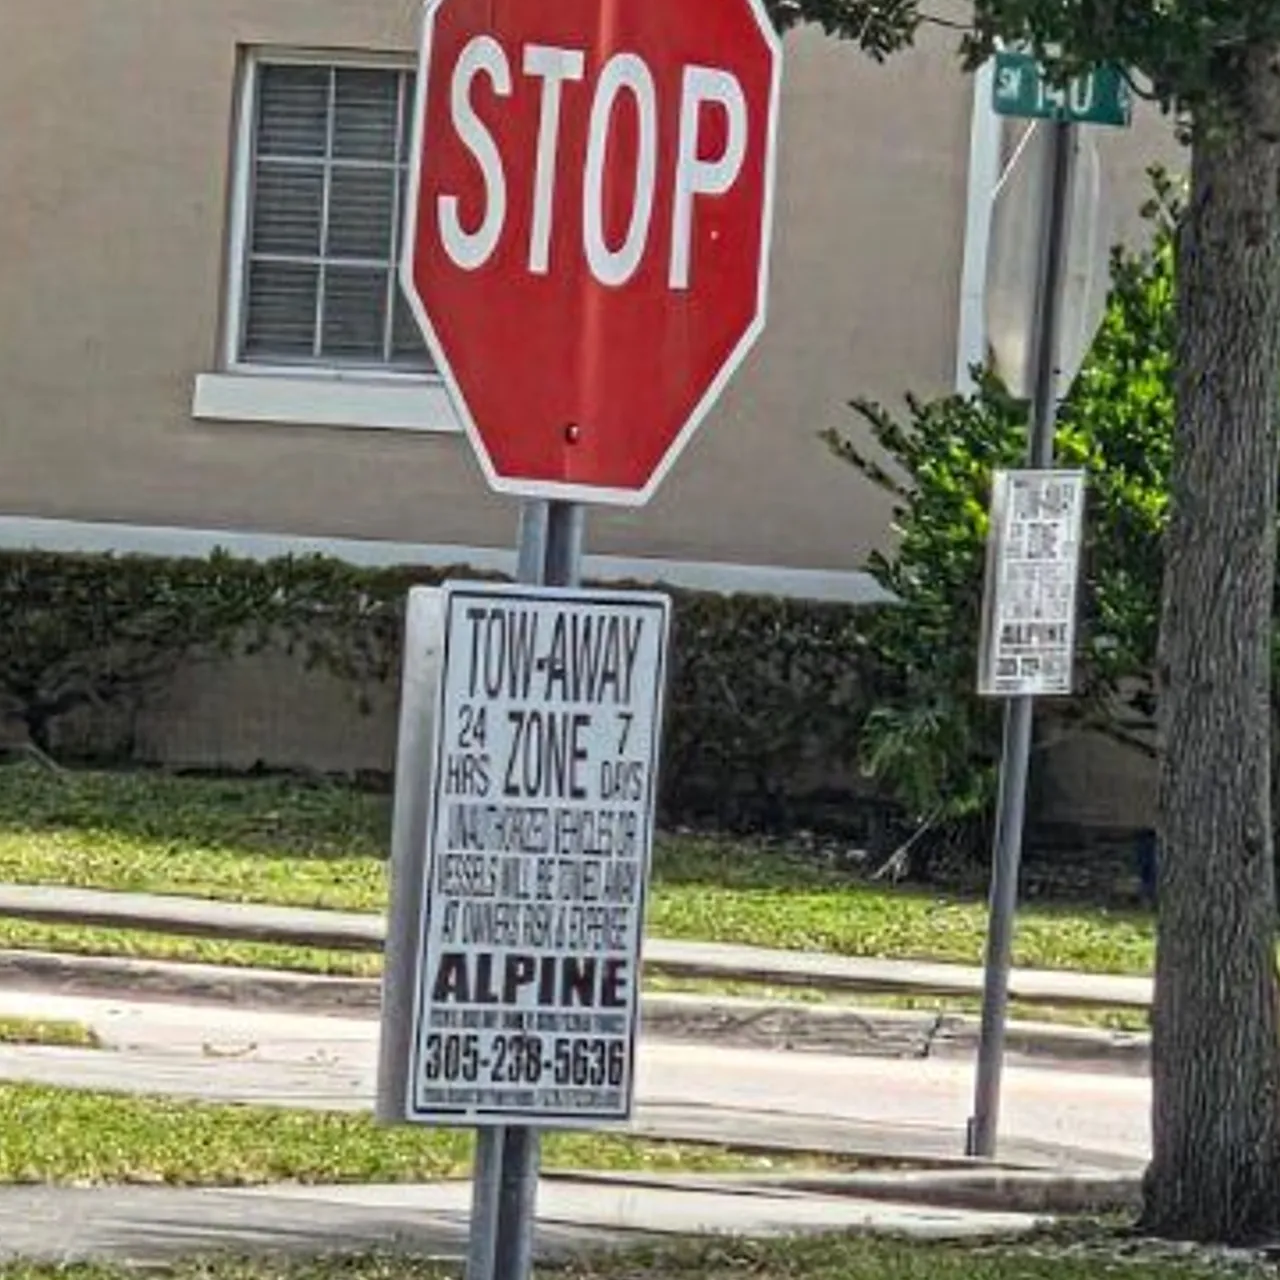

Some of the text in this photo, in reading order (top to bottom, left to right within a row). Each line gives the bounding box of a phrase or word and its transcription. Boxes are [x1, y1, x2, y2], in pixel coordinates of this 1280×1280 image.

[437, 34, 748, 289] STOP
[466, 607, 644, 705] TOW-AWAY
[445, 754, 644, 801] HRS DAYS
[458, 704, 634, 799] 24 ZONE 7
[431, 952, 628, 1008] ALPINE
[425, 1032, 625, 1087] 305-238-5636
